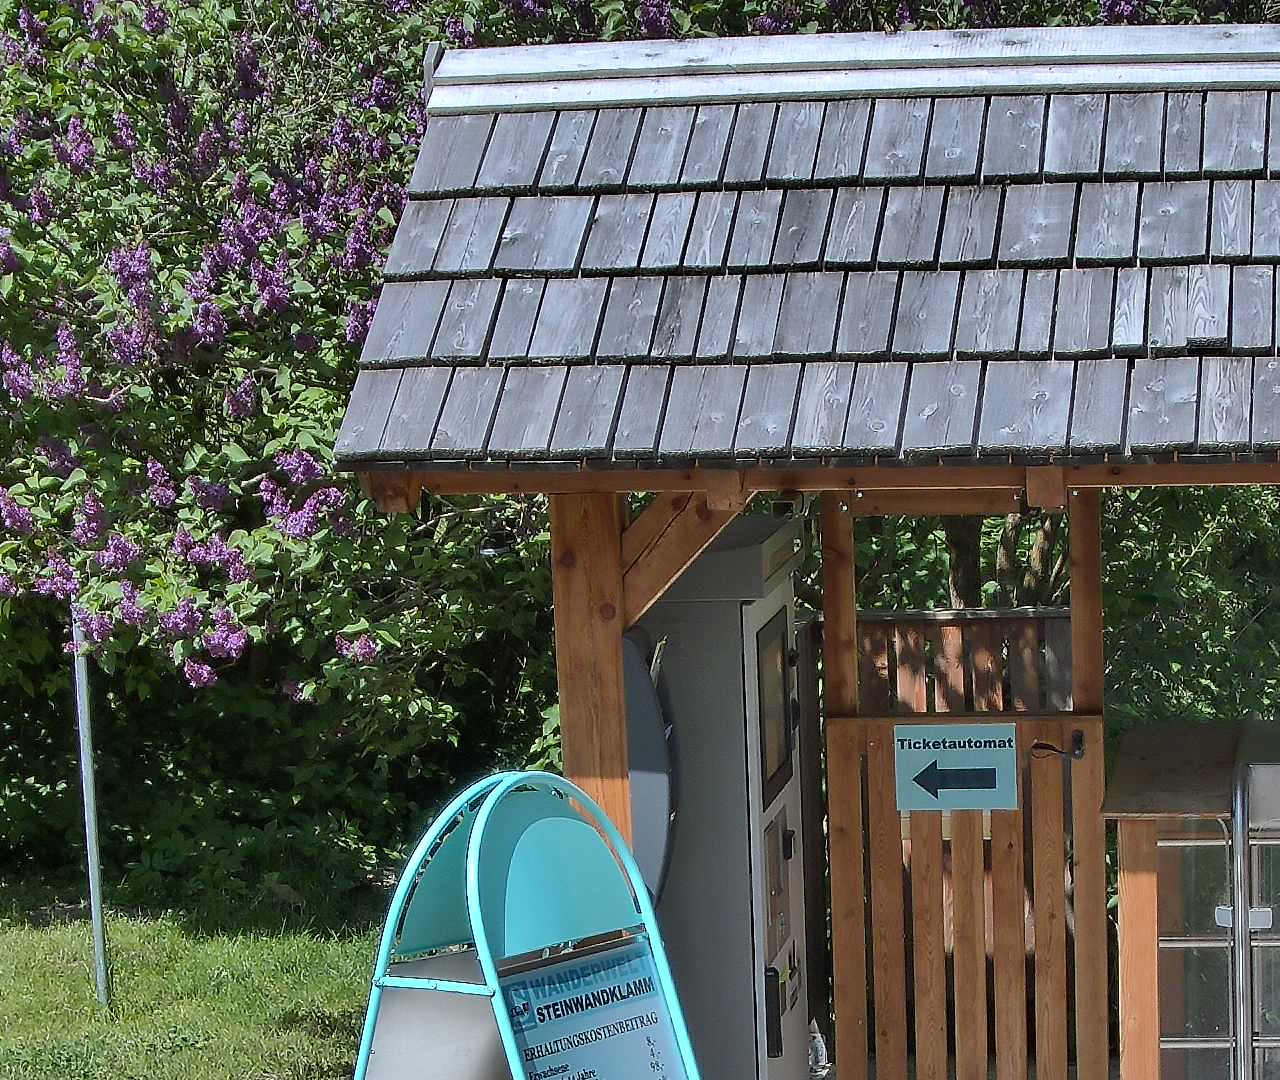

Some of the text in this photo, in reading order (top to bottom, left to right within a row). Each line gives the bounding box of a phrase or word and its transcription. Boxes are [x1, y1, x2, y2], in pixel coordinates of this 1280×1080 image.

[897, 737, 1013, 750] Ticketautomat
[529, 953, 651, 1000] WANDERWELT
[536, 976, 656, 1023] STEINWANDKLAMM
[523, 1011, 658, 1062] ERHALTUNGSKOSTENBEITRAG
